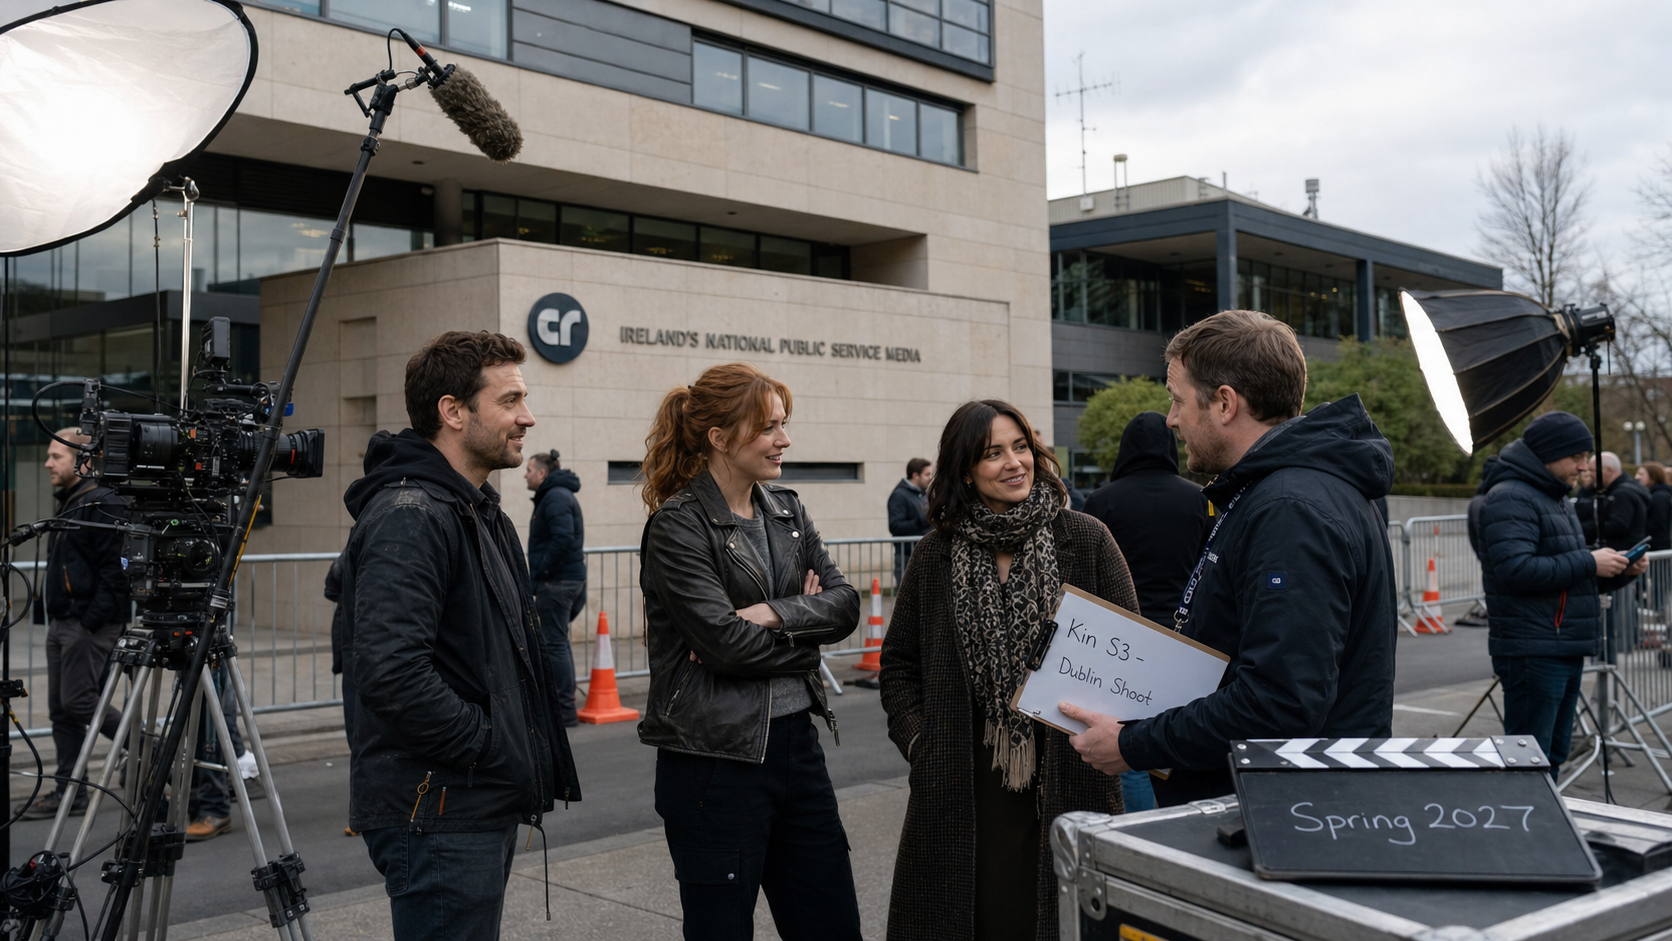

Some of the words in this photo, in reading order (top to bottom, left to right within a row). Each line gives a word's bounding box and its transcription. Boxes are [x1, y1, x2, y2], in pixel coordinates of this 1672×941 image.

[620, 326, 699, 348] IRELAND'S
[705, 332, 776, 353] NATIONAL
[780, 338, 826, 357] PUBLIC
[830, 342, 882, 361] SERVICE
[885, 346, 922, 363] MEDIA
[1066, 618, 1097, 649] Kin
[1105, 637, 1130, 661] S3
[1059, 656, 1102, 689] Dublin
[1109, 677, 1153, 706] Shoot
[1290, 801, 1416, 846] Spring
[1423, 802, 1535, 833] 2027
